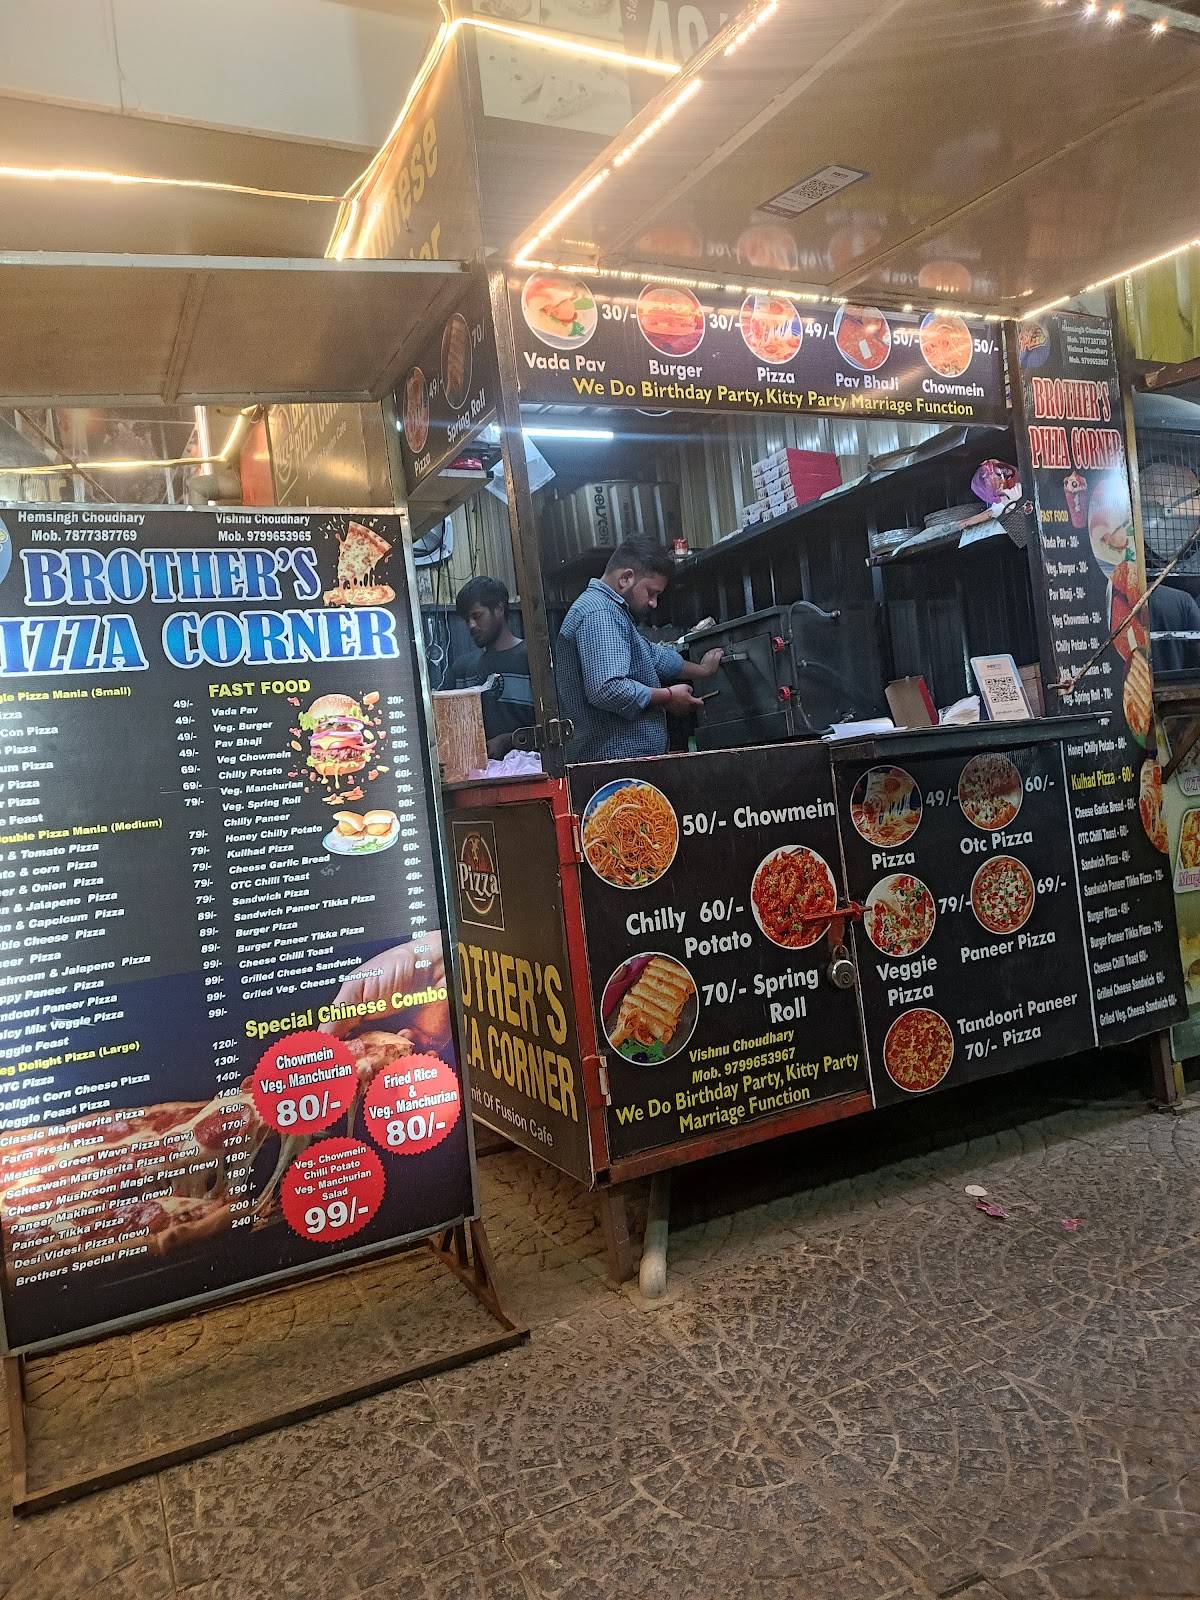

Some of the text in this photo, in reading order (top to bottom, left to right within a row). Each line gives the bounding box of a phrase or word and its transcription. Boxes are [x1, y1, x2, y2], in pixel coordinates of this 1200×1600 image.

[602, 304, 636, 322] 30/-
[710, 314, 743, 331] 30/-
[806, 323, 835, 339] 49/-
[894, 331, 920, 346] 50/-
[975, 339, 999, 354] 50/-
[523, 352, 606, 372] Vada Pav
[649, 360, 702, 380] Burger
[758, 367, 795, 384] Pizza
[836, 373, 860, 388] Pav
[573, 377, 973, 415] We Do Birthday Party, Kitty Party Marriage Function
[922, 380, 984, 397] Chowmein
[1032, 377, 1111, 422] BROTHER'S
[448, 388, 485, 442] Spring Roll
[1028, 426, 1071, 469] PIZZA
[414, 452, 430, 476] Pizza
[18, 513, 145, 527] Hemsingh Choudhary
[216, 514, 310, 527] Vishnu Choudhary
[32, 529, 136, 542] Mob. 7877387769
[218, 530, 311, 542] Mob. 9799653965
[20, 547, 322, 606] BROTHER'S
[0, 606, 400, 678] IZZA CORNER
[18, 687, 131, 701] Pizza Mania (Small)
[208, 680, 311, 697] FAST FOOD
[211, 706, 258, 716] Vada Pav
[213, 721, 273, 733] Veg. Burger
[215, 737, 262, 748] Pav Bhaji
[217, 750, 291, 764] Veg Chowmein
[219, 767, 282, 780] Chilly Potato
[1025, 775, 1055, 793] 60/-
[1071, 766, 1134, 790] Kulhad Pizza 60/-
[220, 781, 303, 796] Veg. Manchurian
[926, 788, 959, 807] 49/-
[682, 798, 836, 836] 50/- Chowmein
[960, 830, 1033, 855] Otc Pizza
[872, 851, 915, 870] Pizza
[458, 861, 500, 897] Pizza
[1037, 875, 1066, 895] 69/-
[234, 894, 375, 921] Sandwich Paneer Tikka Pizza
[939, 894, 971, 914] 79/-
[626, 897, 744, 936] Chilly 60/-
[685, 932, 752, 958] Potato
[961, 930, 1056, 963] Paneer Pizza
[876, 955, 938, 982] Veggie
[458, 942, 567, 1045] OTHER'S
[702, 967, 819, 1006] 70/- Spring
[888, 984, 934, 1007] Pizza
[245, 986, 448, 1039] Special Chinese Combo
[770, 996, 807, 1024] Roll
[957, 992, 1078, 1035] Tandoori Paneer
[689, 1029, 795, 1063] Vishnu Choudhary
[965, 1025, 1042, 1060] 70/- Pizza
[18, 1040, 140, 1072] Delight Pizza (Large)
[276, 1047, 333, 1070] Chowmein
[692, 1047, 796, 1084] Mob. 9799653967
[260, 1064, 352, 1093] Veg. Manchurian
[384, 1066, 437, 1088] Fried Rice
[487, 1024, 578, 1123] CORNER
[409, 1085, 417, 1098] &
[616, 1052, 859, 1126] We Do Birthday Party, Kitty Party
[276, 1090, 341, 1127] 80/-
[369, 1090, 457, 1120] Veg. Manchurian
[471, 1084, 555, 1147] nit Of Fusion Cafe
[680, 1086, 811, 1134] Marriage Function
[386, 1112, 446, 1147] 80/-
[295, 1146, 366, 1170] Veg. Chowmein
[304, 1159, 360, 1180] Chilli Potato
[295, 1169, 371, 1196] Veg. Manchurian
[322, 1188, 348, 1201] Salad
[304, 1197, 369, 1234] 99/-
[13, 1216, 124, 1251] Paneer Tikka Pizza
[15, 1228, 150, 1270] Desi Videsi Pizza (new)
[16, 1245, 148, 1287] Brothers Special Pizza
